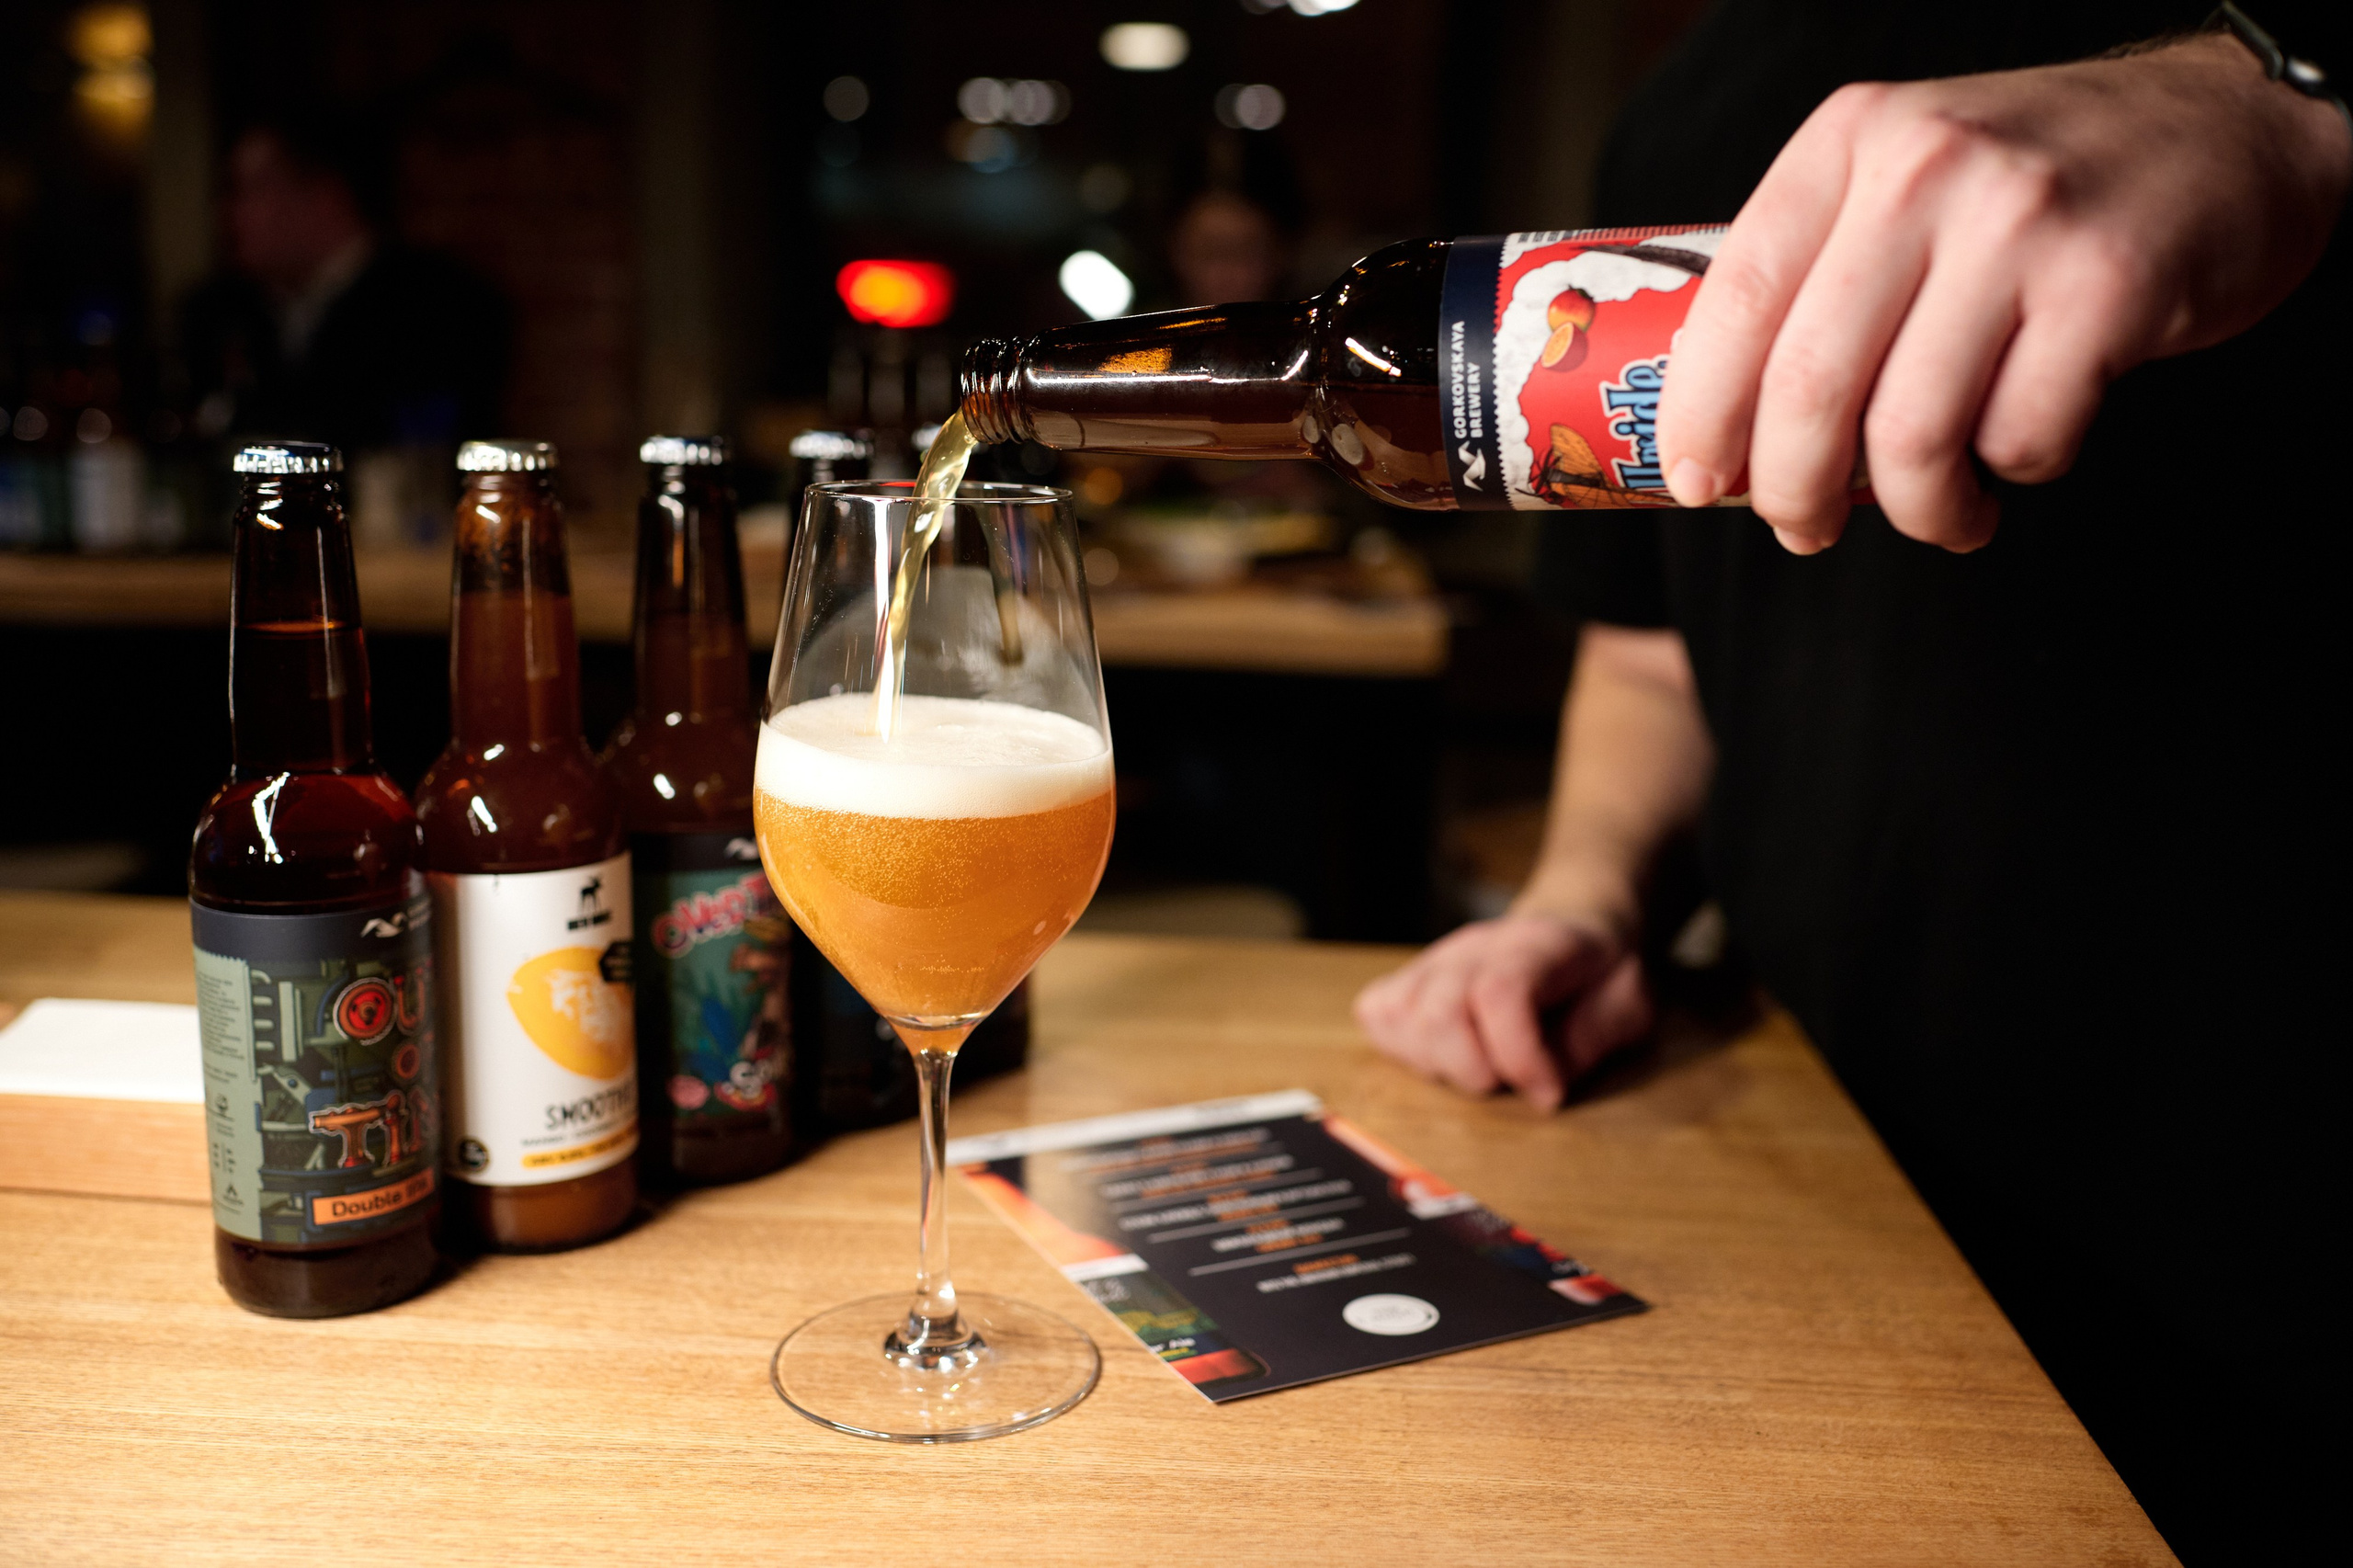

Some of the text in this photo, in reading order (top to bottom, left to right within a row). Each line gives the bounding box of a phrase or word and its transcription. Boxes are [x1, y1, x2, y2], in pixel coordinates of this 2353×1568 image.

[1451, 321, 1467, 439] GORKOVSKAYA
[1467, 362, 1483, 438] BREWERY
[332, 1191, 403, 1218] Double
